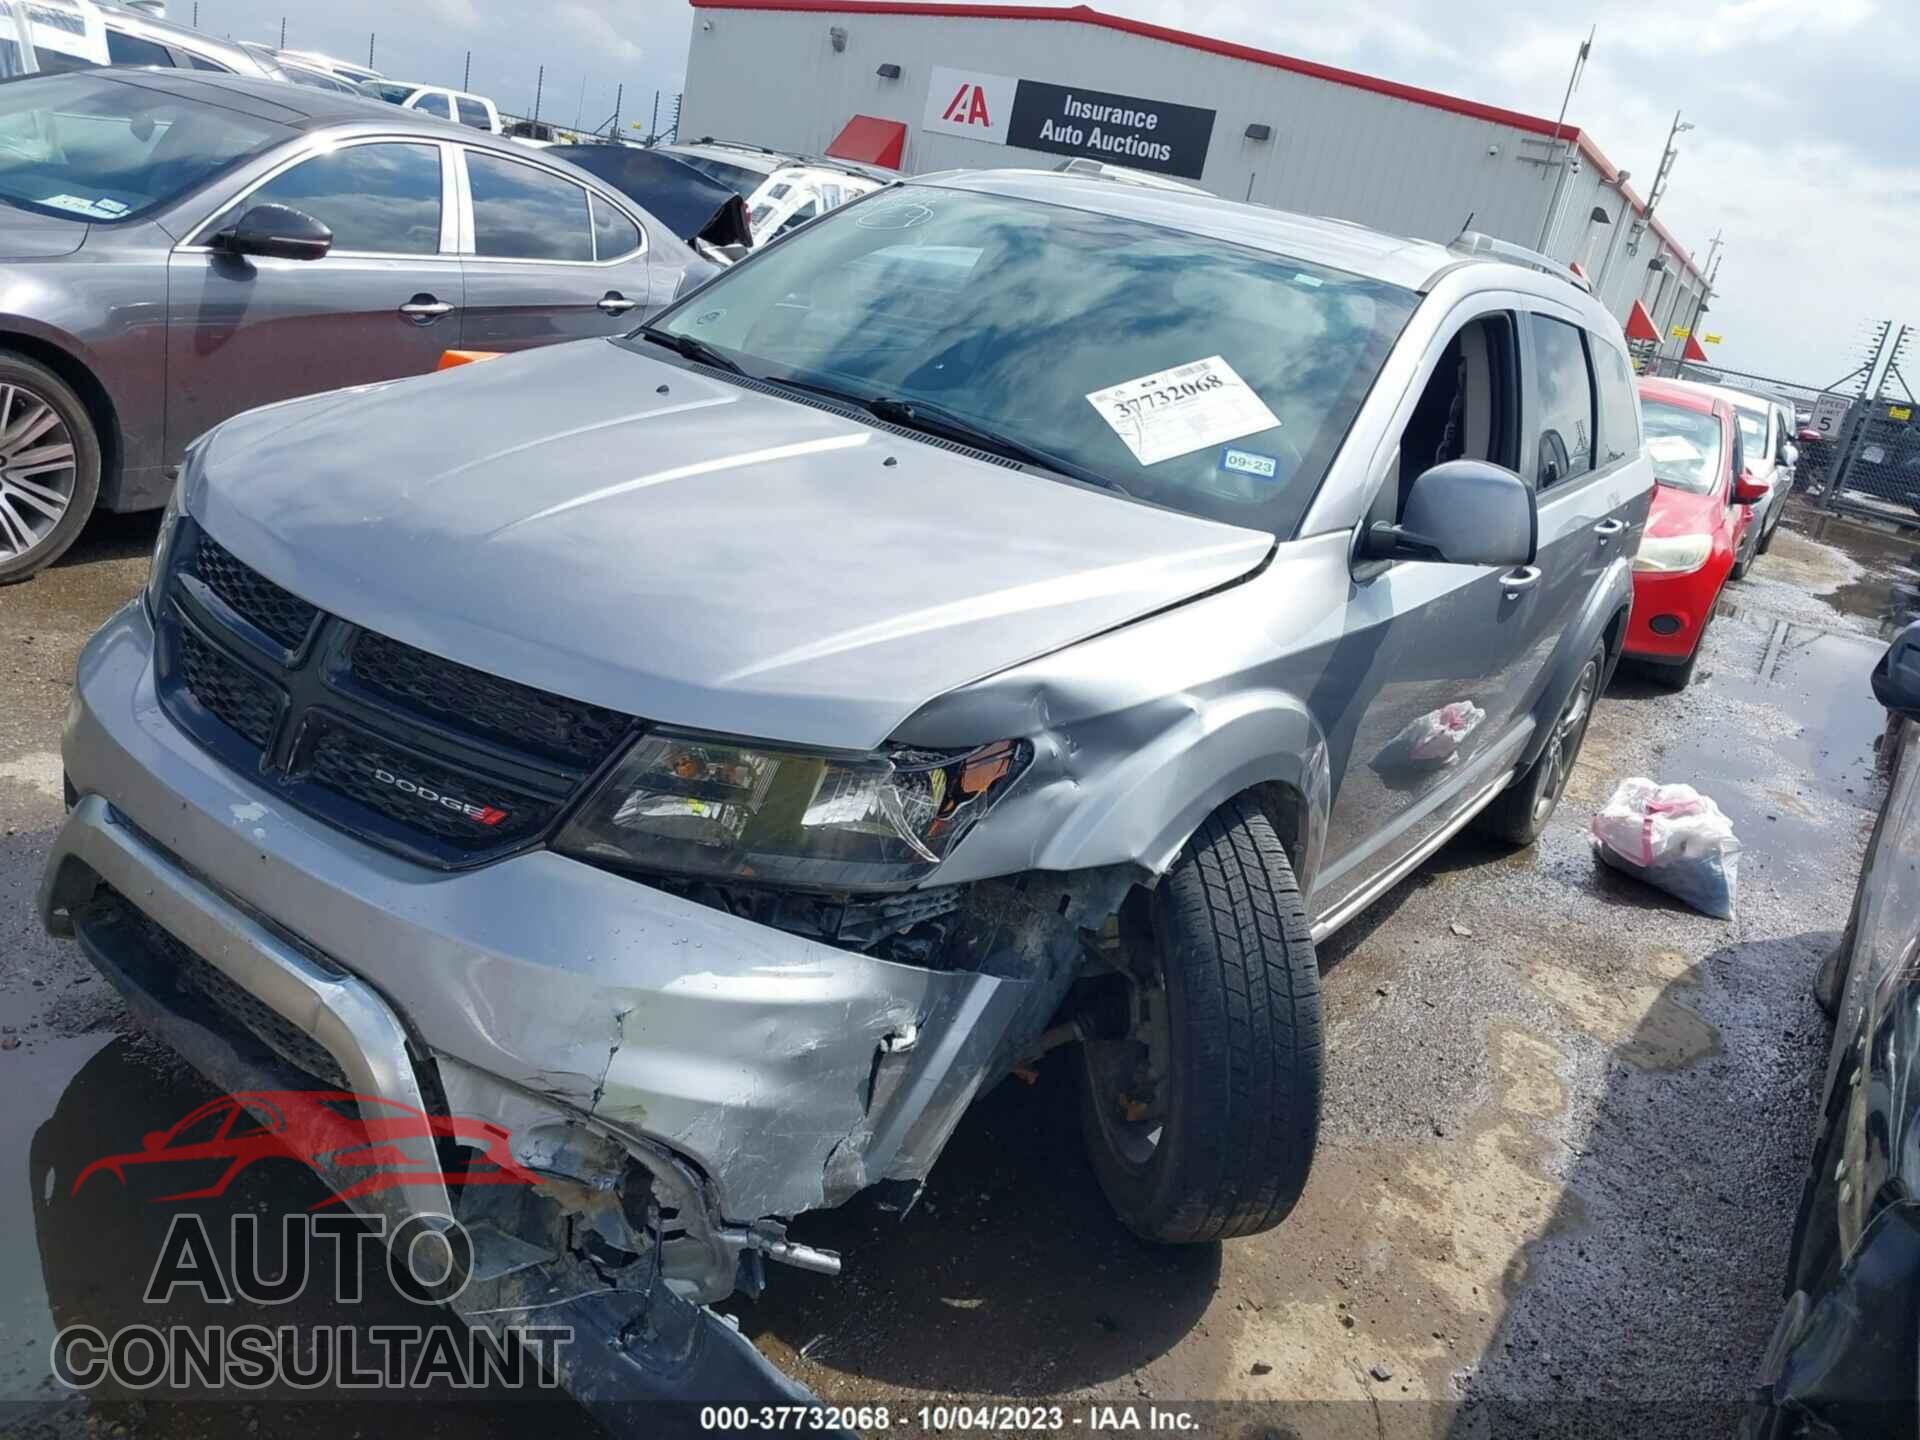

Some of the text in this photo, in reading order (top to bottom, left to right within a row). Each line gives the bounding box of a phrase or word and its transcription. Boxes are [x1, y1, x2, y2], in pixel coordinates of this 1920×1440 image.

[1063, 94, 1158, 130] Insurance
[1040, 119, 1172, 161] Auto Auctions
[1113, 374, 1224, 417] 37732068
[1818, 417, 1833, 432] 5
[375, 768, 486, 820] DODGE
